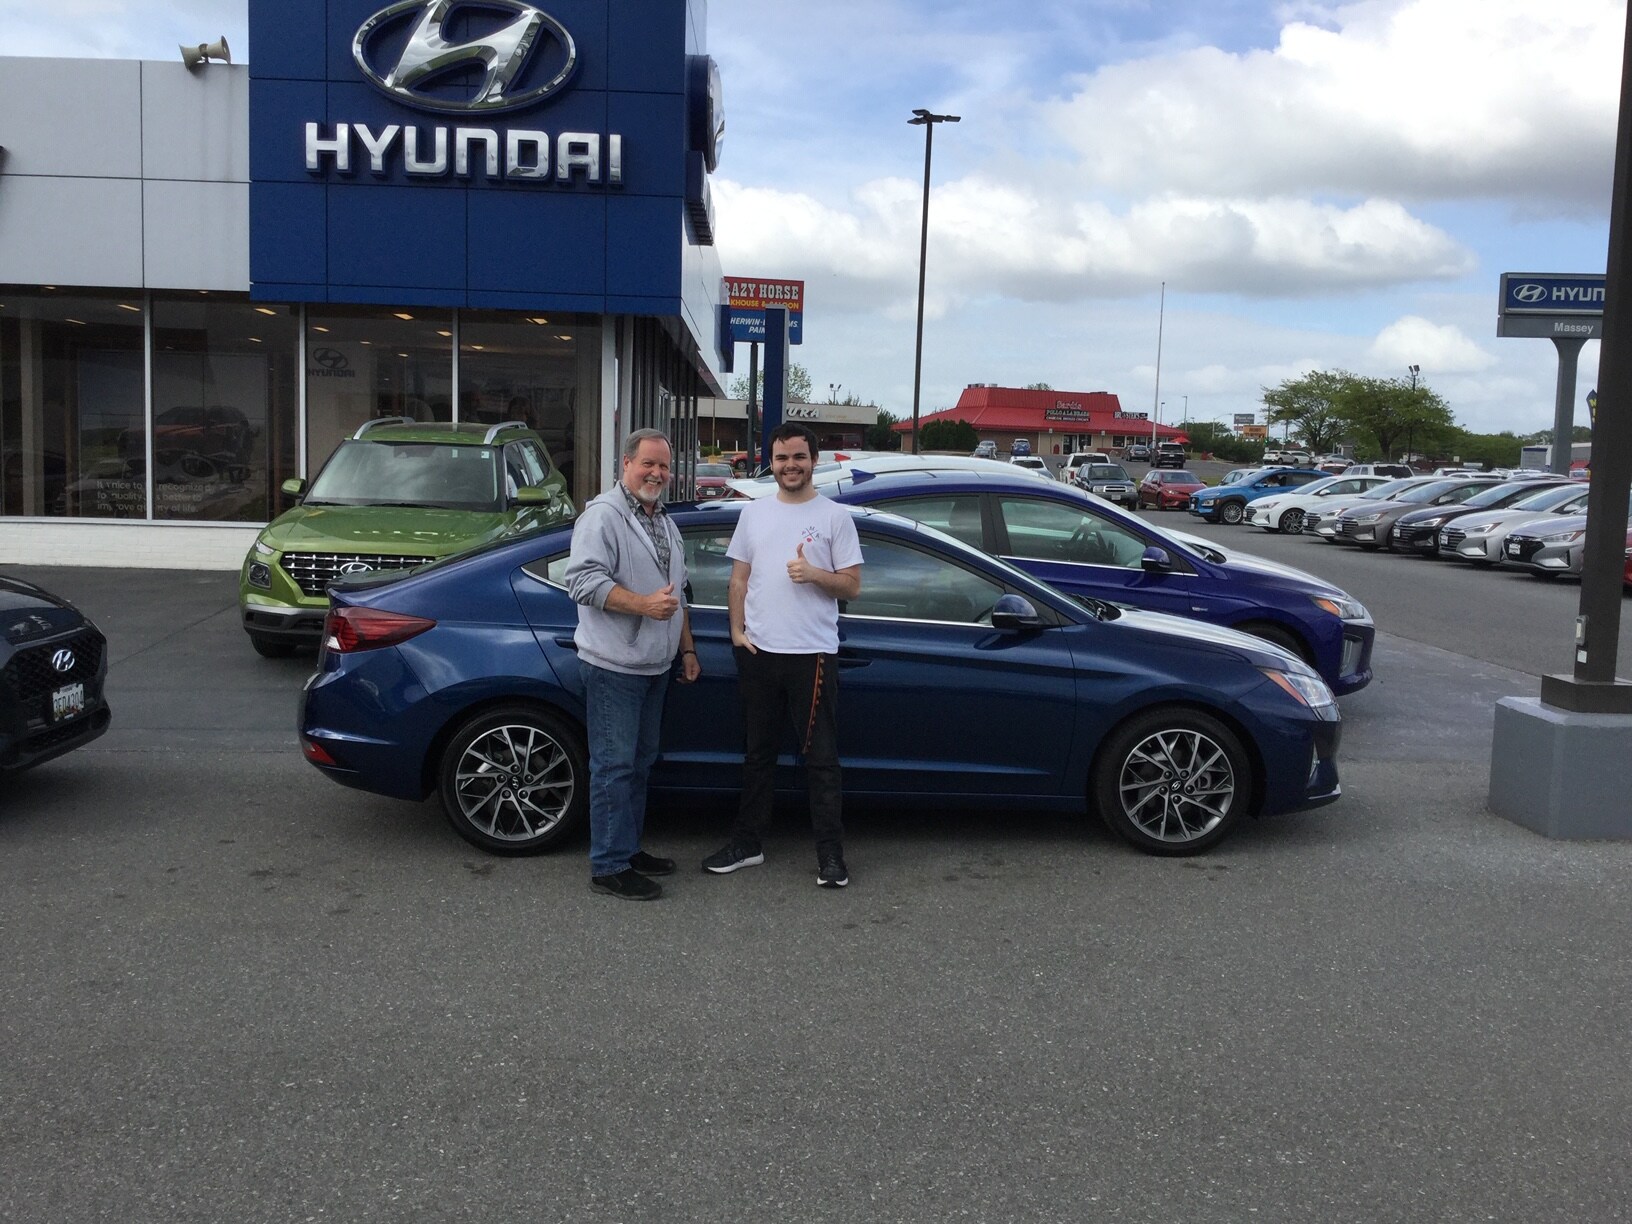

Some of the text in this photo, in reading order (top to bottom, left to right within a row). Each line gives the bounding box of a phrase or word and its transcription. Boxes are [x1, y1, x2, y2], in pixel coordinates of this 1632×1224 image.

[305, 122, 622, 181] HYUNDAI
[725, 282, 799, 300] RAZY HORSE
[1552, 287, 1605, 302] HYUN
[730, 299, 759, 307] KHOUSE
[1554, 322, 1594, 334] Massey
[307, 369, 355, 378] HYUNDAI
[112, 480, 131, 490] nice
[133, 481, 143, 490] to
[162, 491, 191, 502] better
